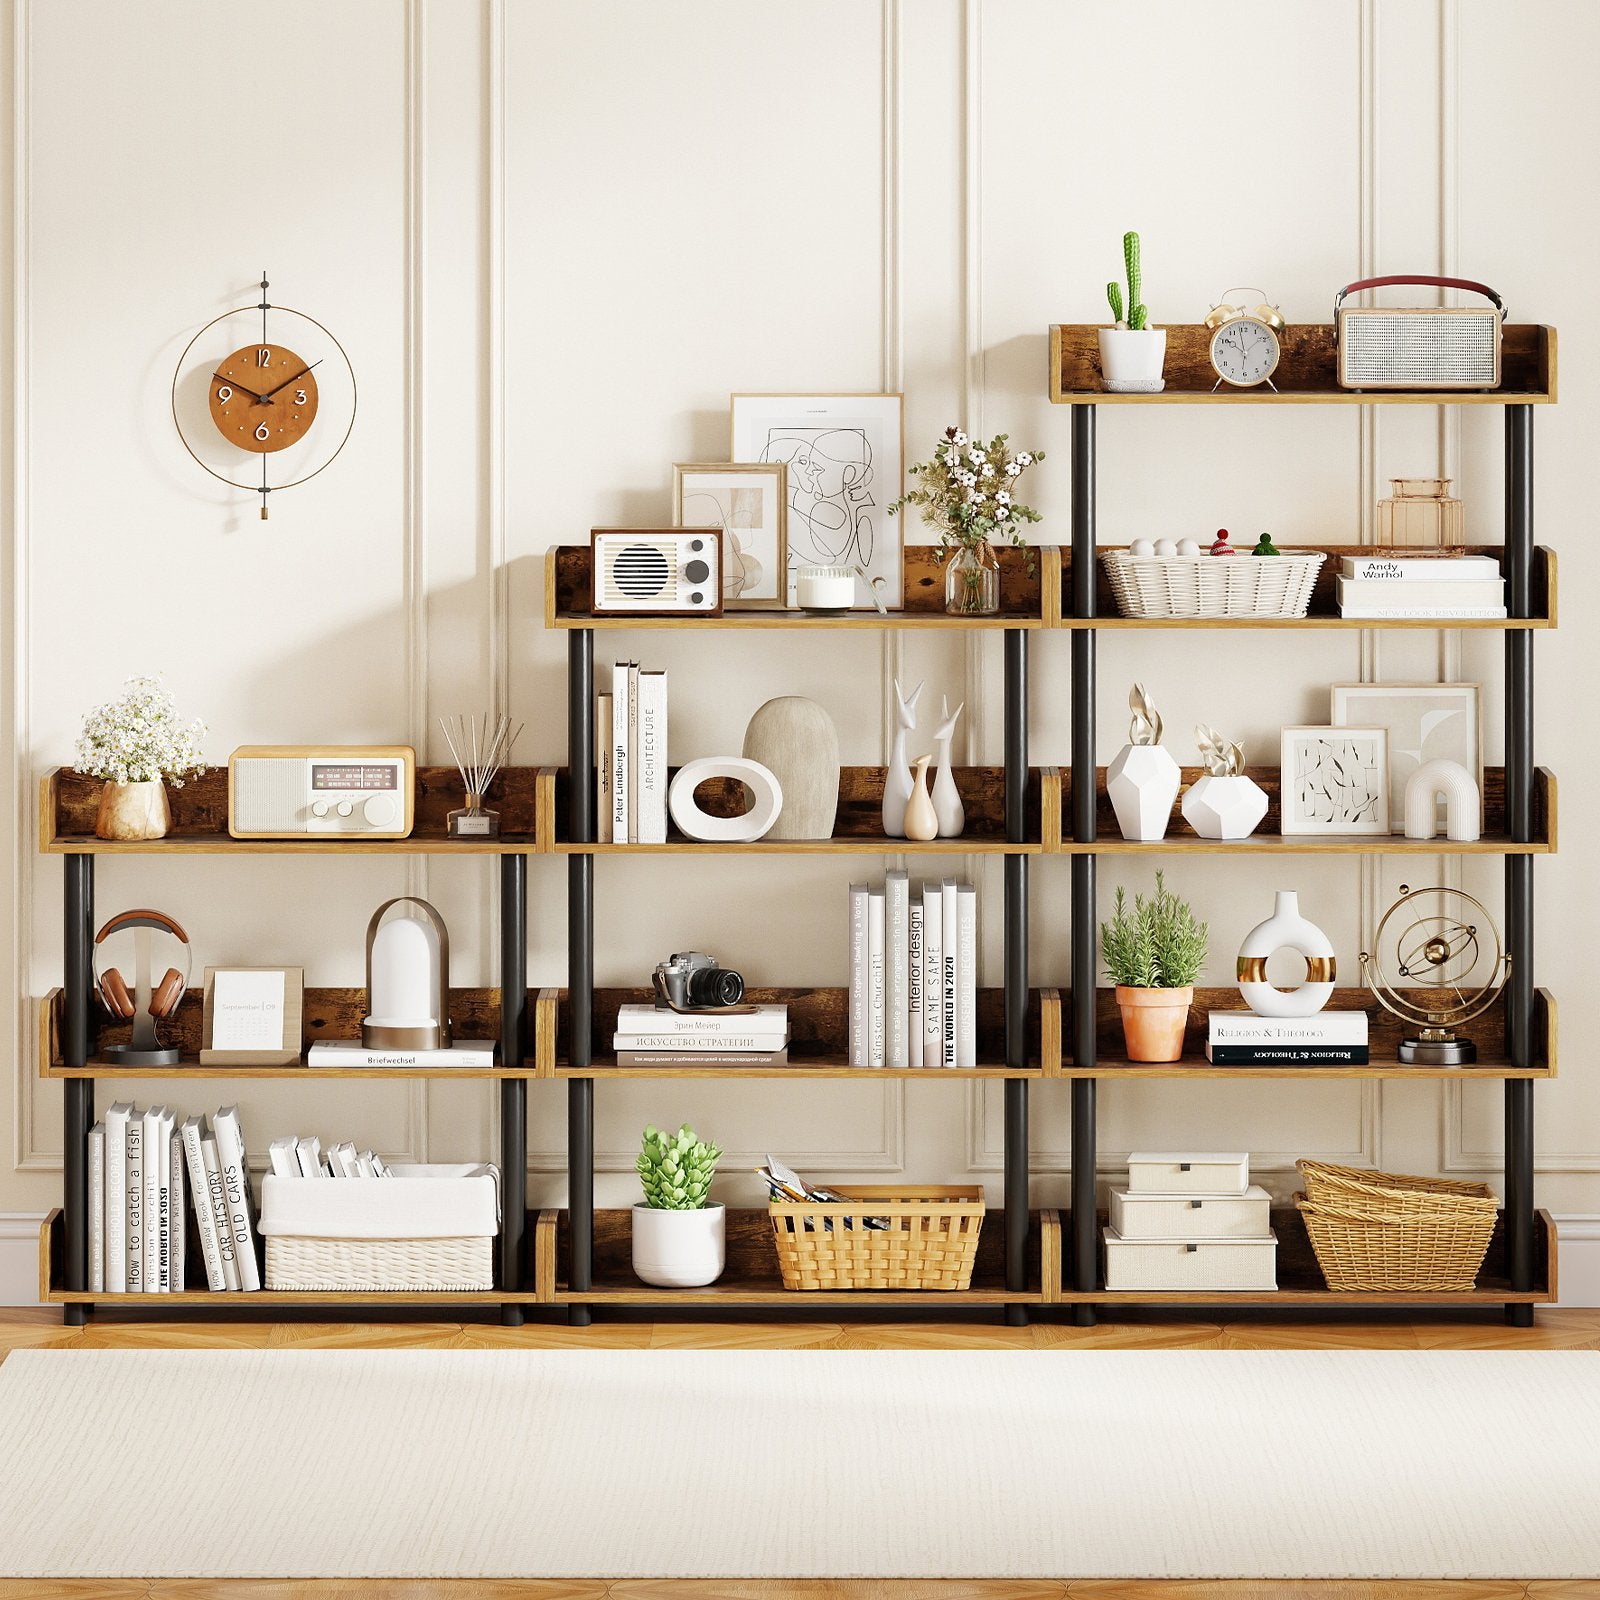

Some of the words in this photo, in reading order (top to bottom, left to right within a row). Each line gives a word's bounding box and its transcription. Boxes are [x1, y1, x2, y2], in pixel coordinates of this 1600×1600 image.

[258, 349, 270, 367] 12
[218, 386, 232, 405] 9
[294, 390, 307, 405] 3
[255, 421, 270, 440] 6
[1362, 571, 1403, 579] Warhol
[1367, 563, 1398, 572] Andy
[645, 709, 654, 790] ARCHITECTURE
[616, 745, 626, 795] Lindbergh
[893, 928, 900, 938] in
[909, 911, 922, 959] design
[854, 932, 863, 963] Hawking
[961, 919, 971, 974] DECORATES
[928, 947, 939, 985] SAME
[945, 956, 953, 985] 2020
[854, 967, 862, 998] Stephen
[872, 953, 882, 1009] Churchill
[909, 963, 920, 1012] Interior
[945, 988, 953, 999] IN
[222, 1003, 260, 1011] September
[895, 996, 900, 1006] an
[961, 983, 971, 1040] HOUSEHOLD
[674, 1021, 693, 1030] Эрин
[695, 1021, 720, 1030] Мейер
[928, 995, 939, 1034] SAME
[945, 1002, 953, 1041] WORLD
[636, 1038, 696, 1046] ИСКУССТВО
[698, 1038, 754, 1046] СТРАТЕГИИ
[873, 1015, 882, 1060] Winston
[894, 1034, 900, 1043] to
[1263, 1028, 1273, 1037] &
[945, 1044, 953, 1063] THE
[128, 1129, 140, 1160] fish
[188, 1130, 200, 1174] children
[110, 1138, 120, 1198] DECORATES
[196, 1181, 204, 1196] for
[224, 1165, 241, 1204] CARS
[128, 1186, 140, 1227] catch
[200, 1200, 209, 1222] Book
[208, 1170, 229, 1228] HISTORY
[110, 1205, 120, 1265] HOUSEHOLD
[173, 1222, 181, 1233] by
[203, 1227, 214, 1249] DRAW
[233, 1213, 248, 1243] OLD
[128, 1236, 140, 1251] to
[220, 1236, 235, 1262] CAR
[209, 1254, 215, 1265] TO
[128, 1260, 140, 1285] How
[212, 1270, 220, 1287] HOW
